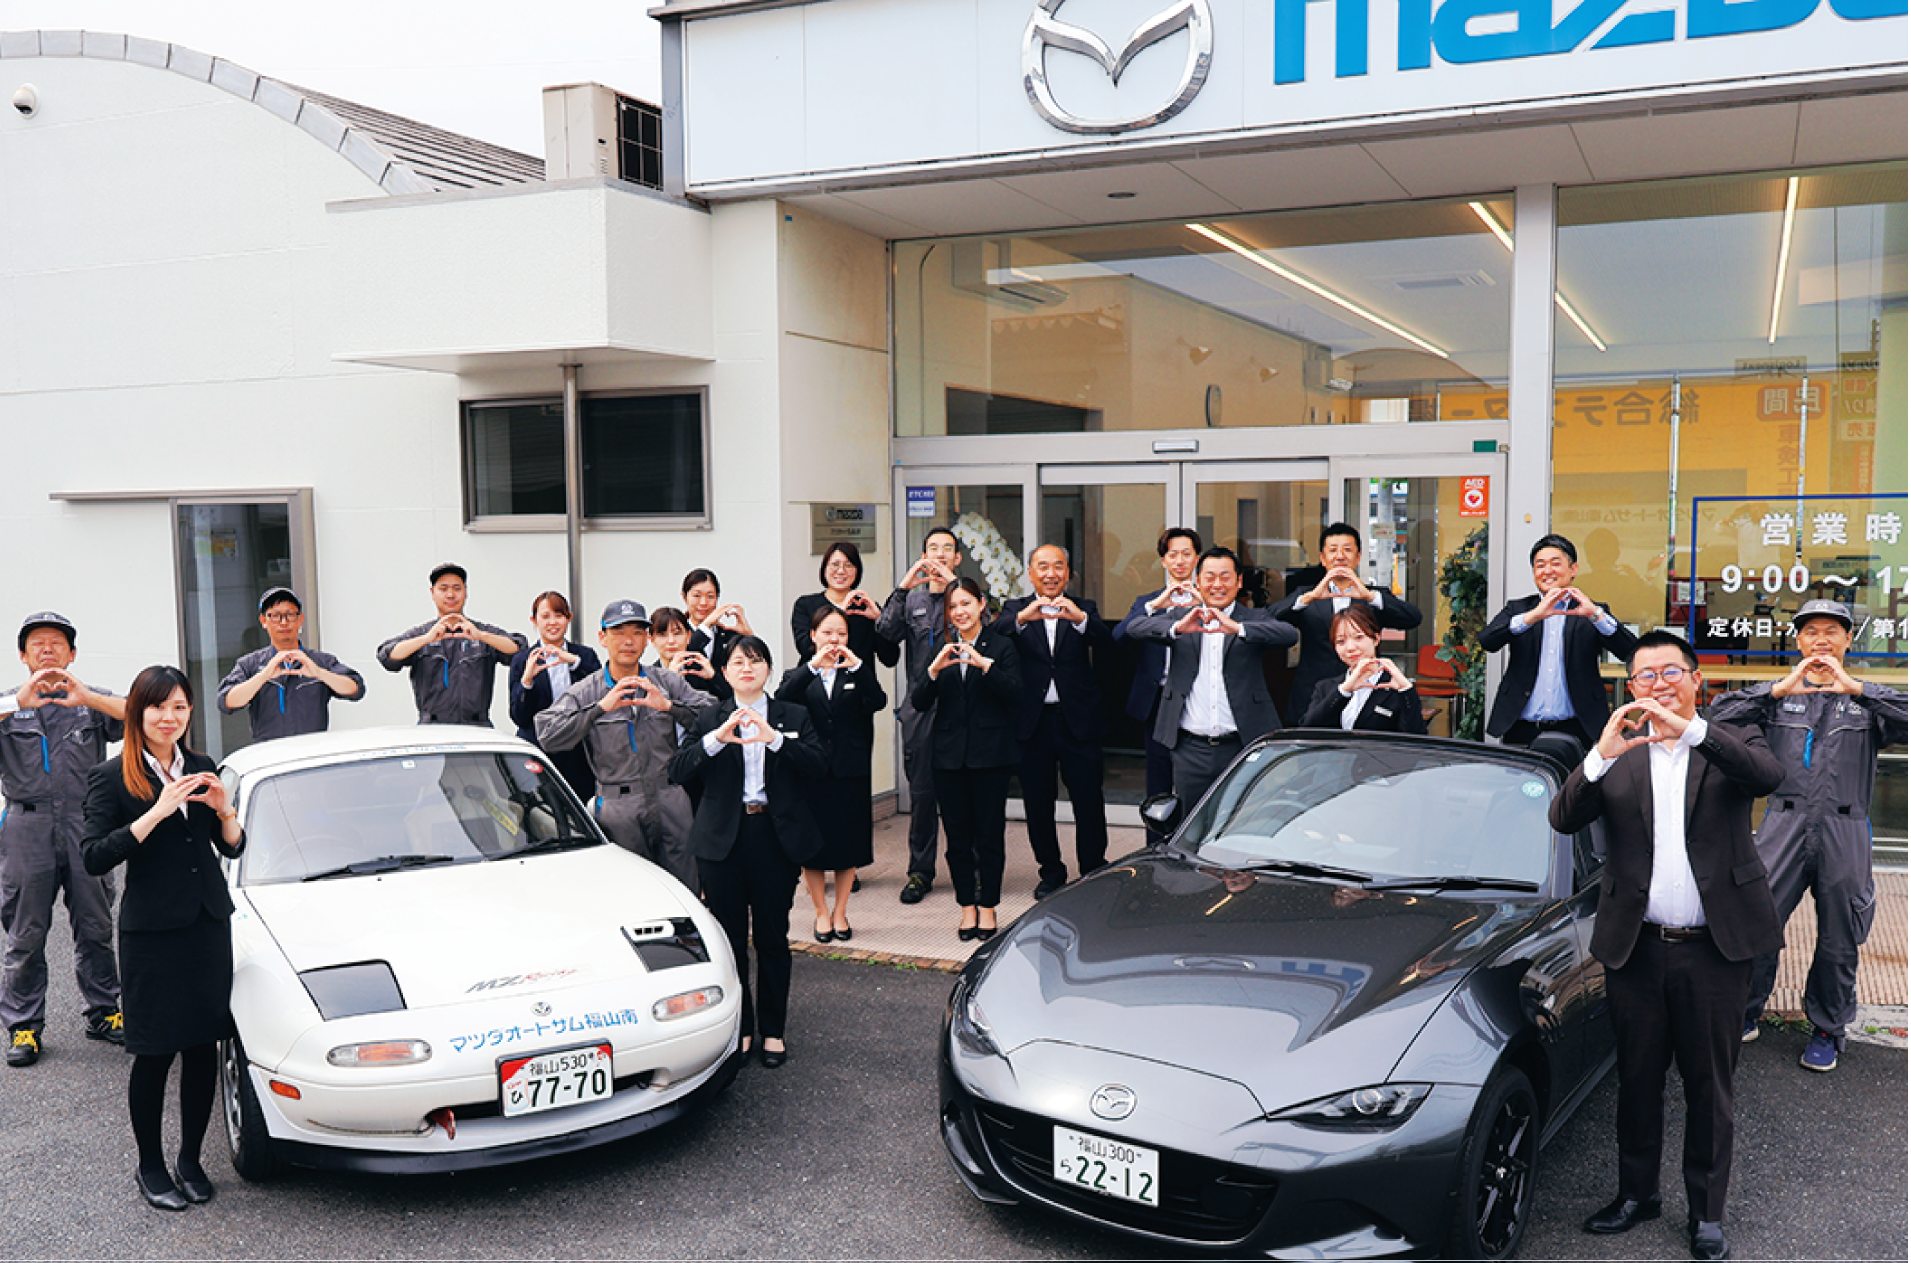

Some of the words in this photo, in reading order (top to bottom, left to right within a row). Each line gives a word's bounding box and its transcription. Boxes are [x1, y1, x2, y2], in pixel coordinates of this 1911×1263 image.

[1274, 0, 1908, 84] maz
[1464, 479, 1485, 488] AED
[1760, 512, 1903, 546] 営業時
[1721, 564, 1810, 593] 9:00
[450, 1009, 638, 1053] マツダオートザム福山南
[528, 1068, 606, 1107] 77-70
[1078, 1136, 1134, 1163] 福山300
[1076, 1156, 1153, 1202] 22-12
